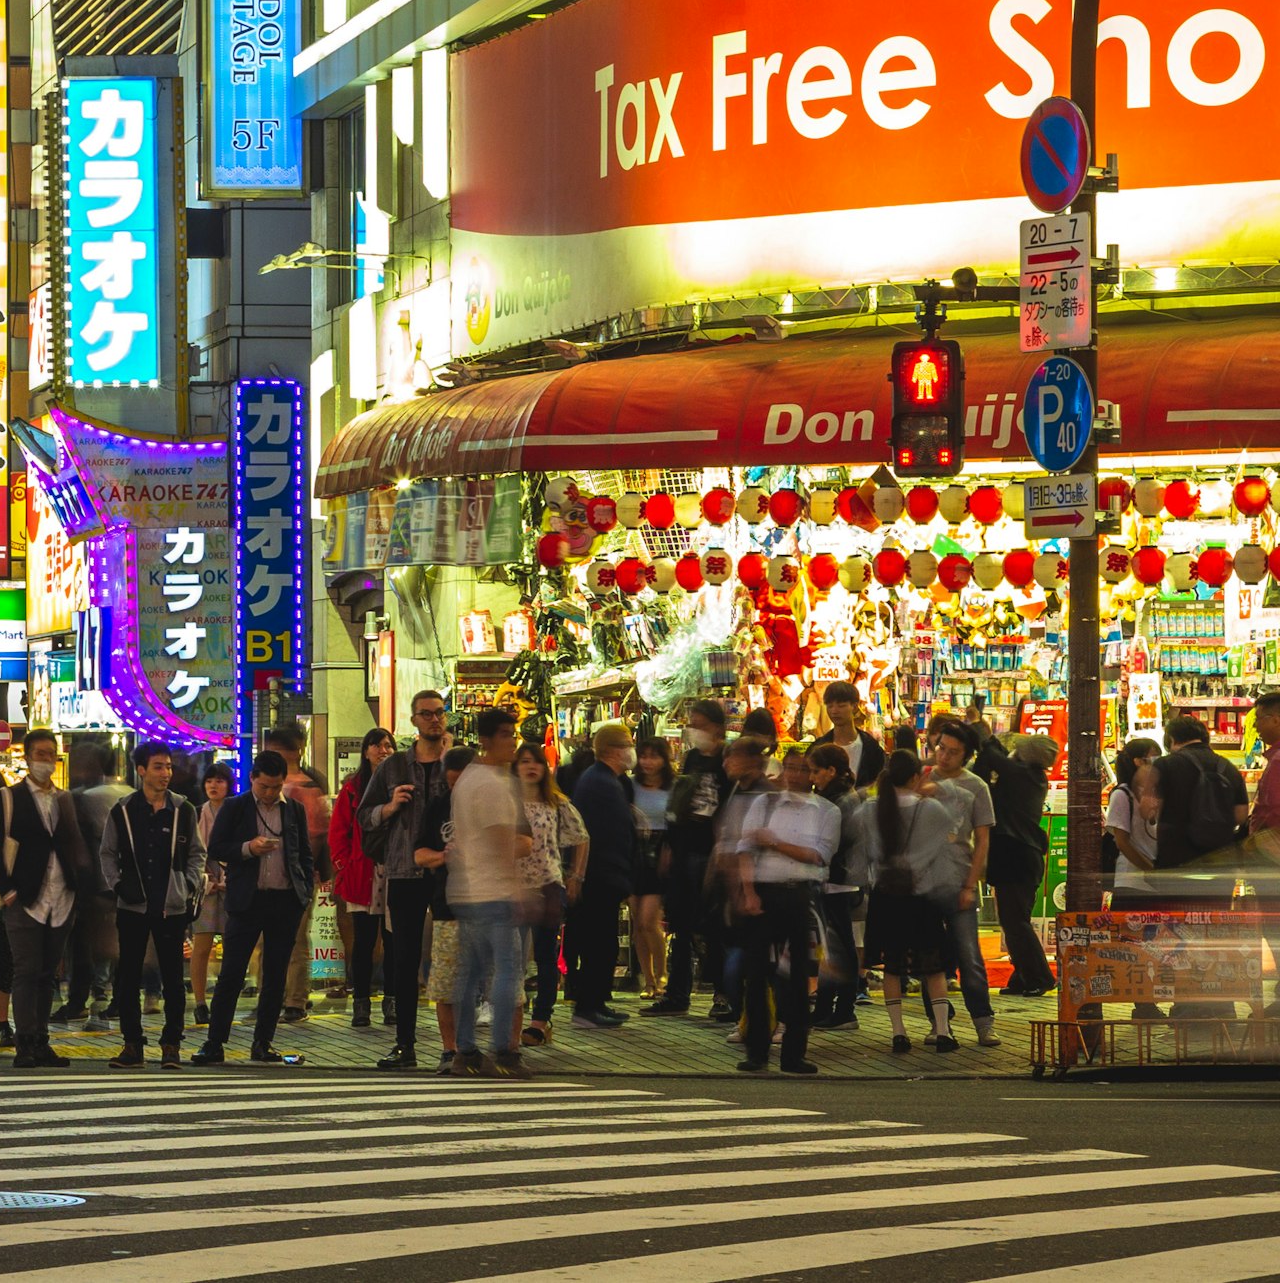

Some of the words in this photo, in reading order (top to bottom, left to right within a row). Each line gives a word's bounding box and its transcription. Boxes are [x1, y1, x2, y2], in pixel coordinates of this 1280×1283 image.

[232, 118, 281, 151] 5F
[595, 63, 685, 179] Tax
[711, 29, 938, 152] Free
[78, 88, 149, 372] カラオケ
[1038, 385, 1064, 456] P
[244, 393, 294, 618] カラオケ
[161, 526, 210, 710] カラオケ
[706, 556, 729, 577] 祭
[245, 629, 292, 664] B1
